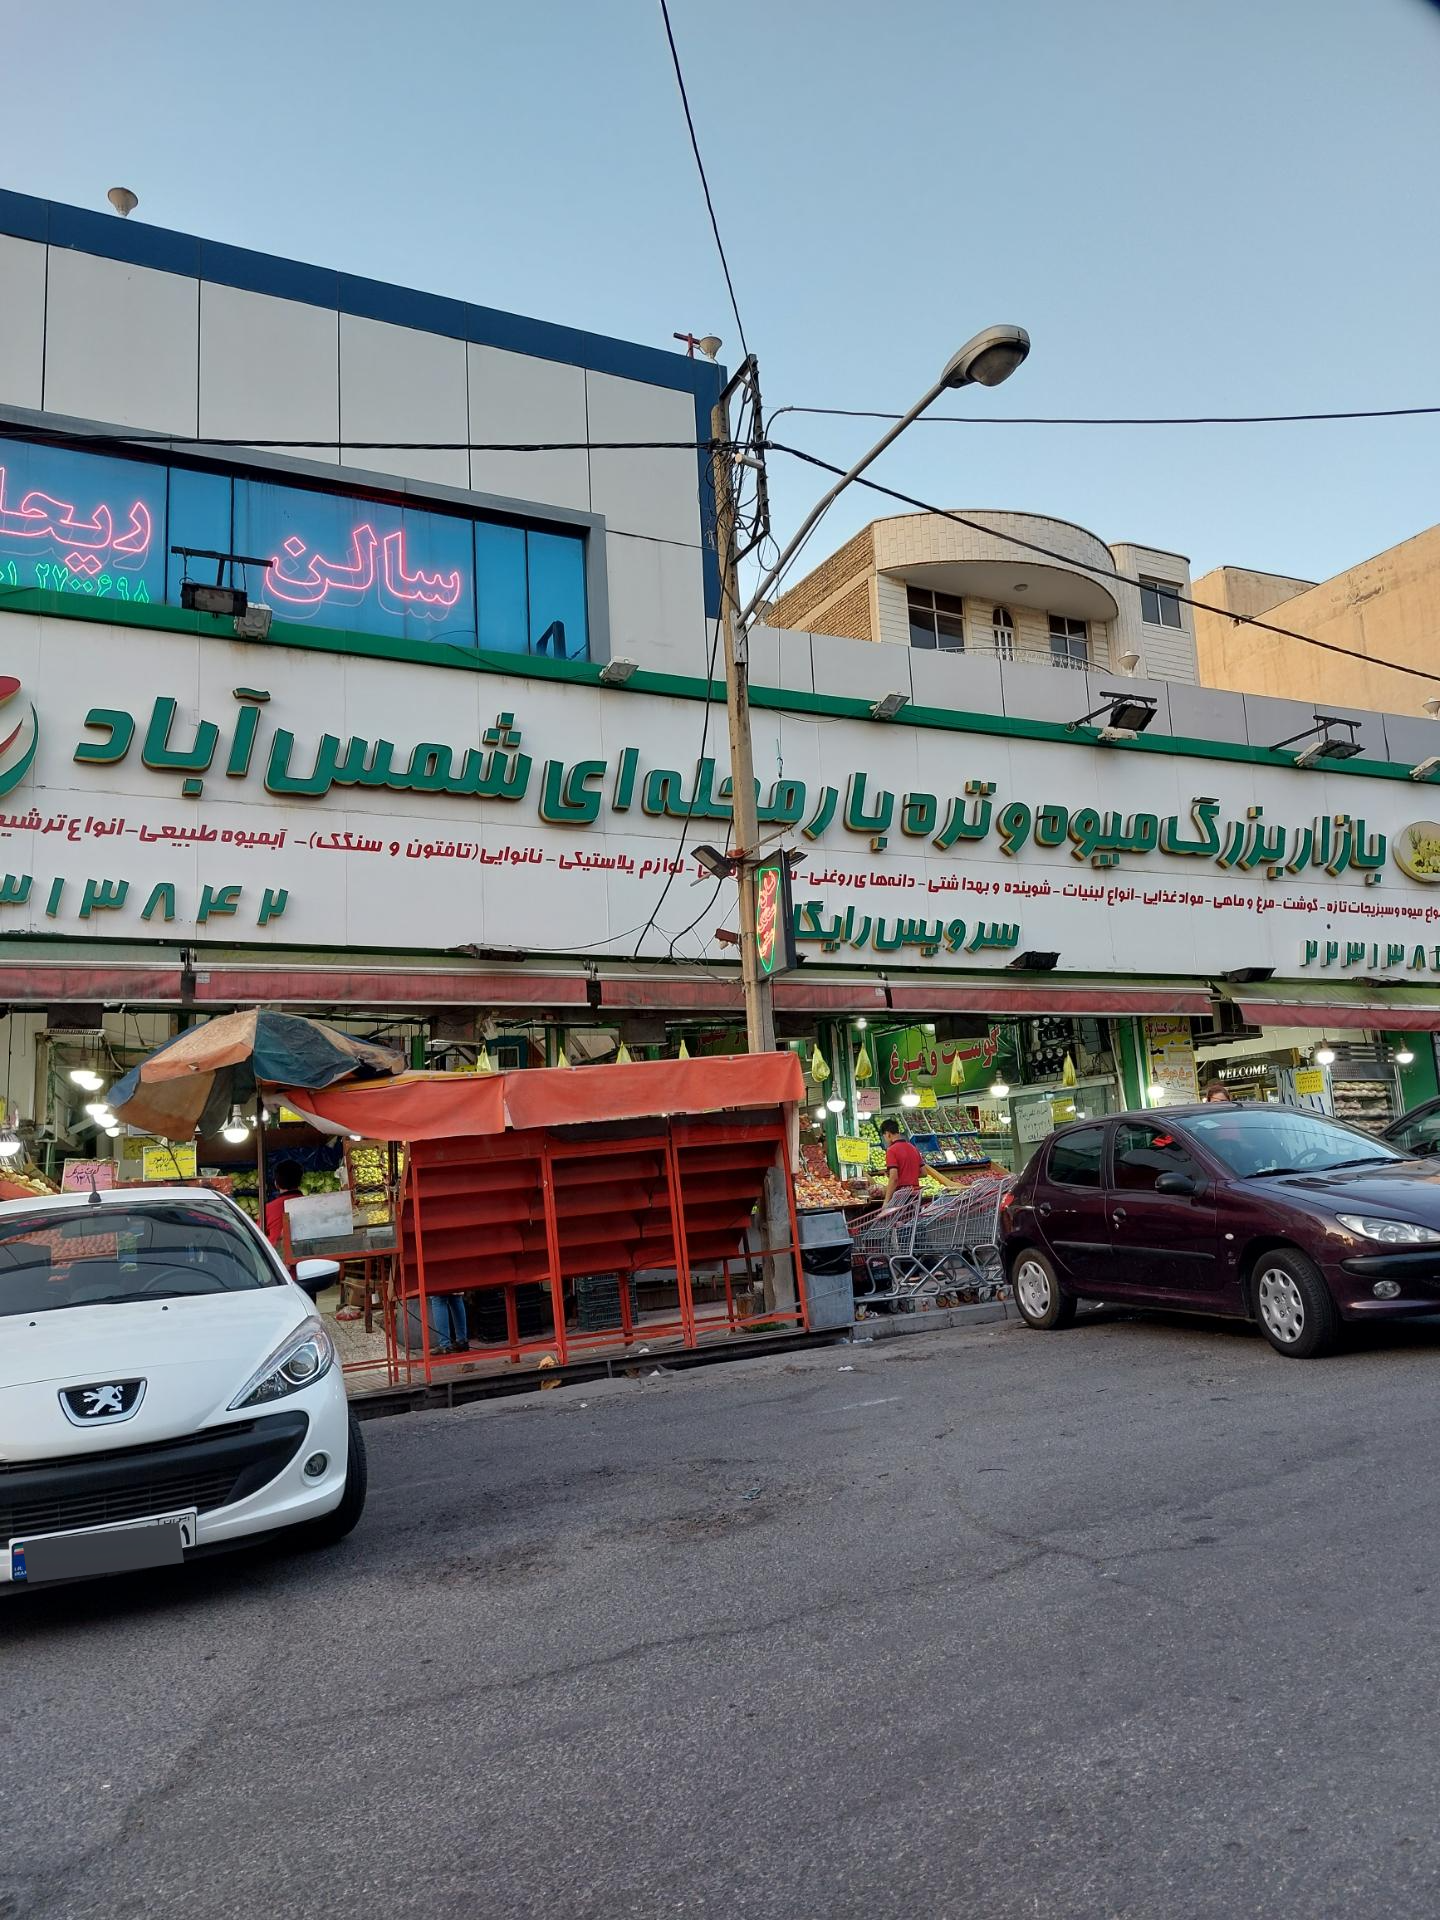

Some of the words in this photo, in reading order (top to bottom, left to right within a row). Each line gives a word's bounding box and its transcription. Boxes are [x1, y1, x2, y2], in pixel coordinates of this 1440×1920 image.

[264, 524, 461, 606] سالن
[73, 686, 271, 797] آباد
[263, 711, 533, 799] شمس
[67, 815, 126, 842] انواع
[136, 823, 219, 848] طبیعی
[220, 828, 289, 851] آبمیوه
[997, 800, 1032, 856] و
[1035, 803, 1158, 870] میوه
[1160, 796, 1287, 880] بزرگ
[388, 841, 401, 857] و
[479, 845, 544, 866] نانوایی
[1284, 812, 1388, 885] بازار
[639, 857, 689, 880] لوازم
[809, 869, 853, 888] روغنی
[991, 882, 1001, 896] و
[1004, 878, 1052, 899] شوینده
[1062, 883, 1105, 902] لبنیات
[1106, 886, 1137, 907] انواع
[1213, 893, 1245, 910] ماهی
[1246, 897, 1254, 910] و
[1255, 895, 1275, 915] مرغ
[1282, 895, 1319, 914] گوشت
[1326, 900, 1348, 915] تازه
[1401, 907, 1423, 920] میوه
[794, 900, 872, 952] رایگا
[870, 918, 1020, 957] سرویس
[889, 1043, 925, 1085] مرغ
[930, 1049, 938, 1078] و
[1218, 1063, 1268, 1079] WELCOME
